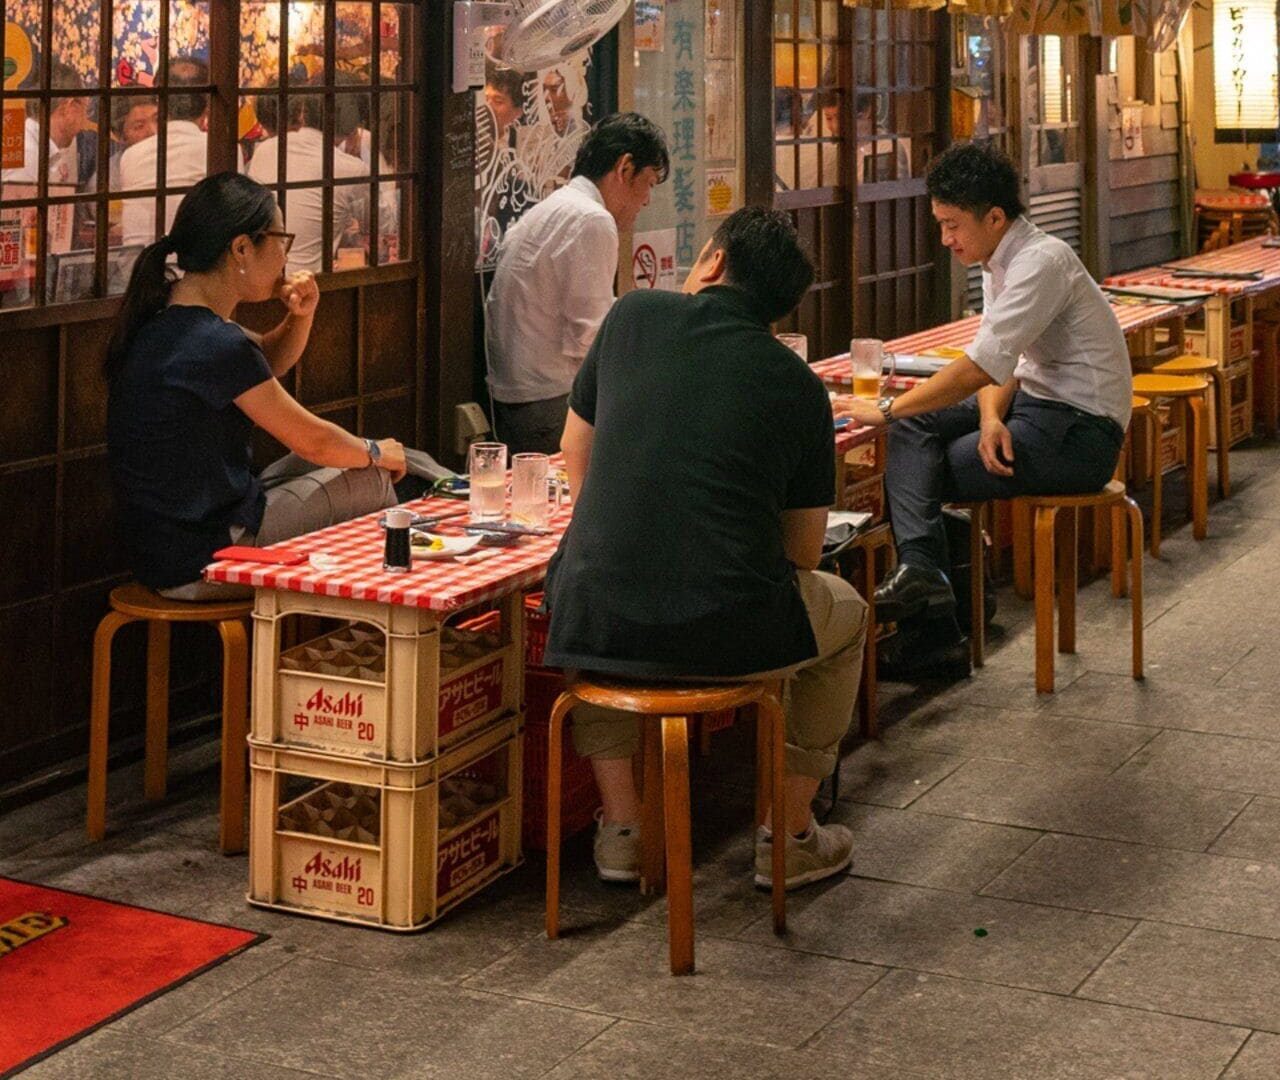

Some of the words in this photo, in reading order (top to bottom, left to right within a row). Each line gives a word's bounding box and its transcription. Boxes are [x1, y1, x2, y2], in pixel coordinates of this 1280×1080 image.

[306, 687, 364, 718] Asahi
[293, 712, 309, 731] 中
[336, 718, 353, 730] BEER
[357, 721, 375, 742] 20
[304, 851, 362, 883] Asahi
[291, 875, 308, 894] 中
[335, 882, 352, 895] BEER
[356, 886, 374, 907] 20
